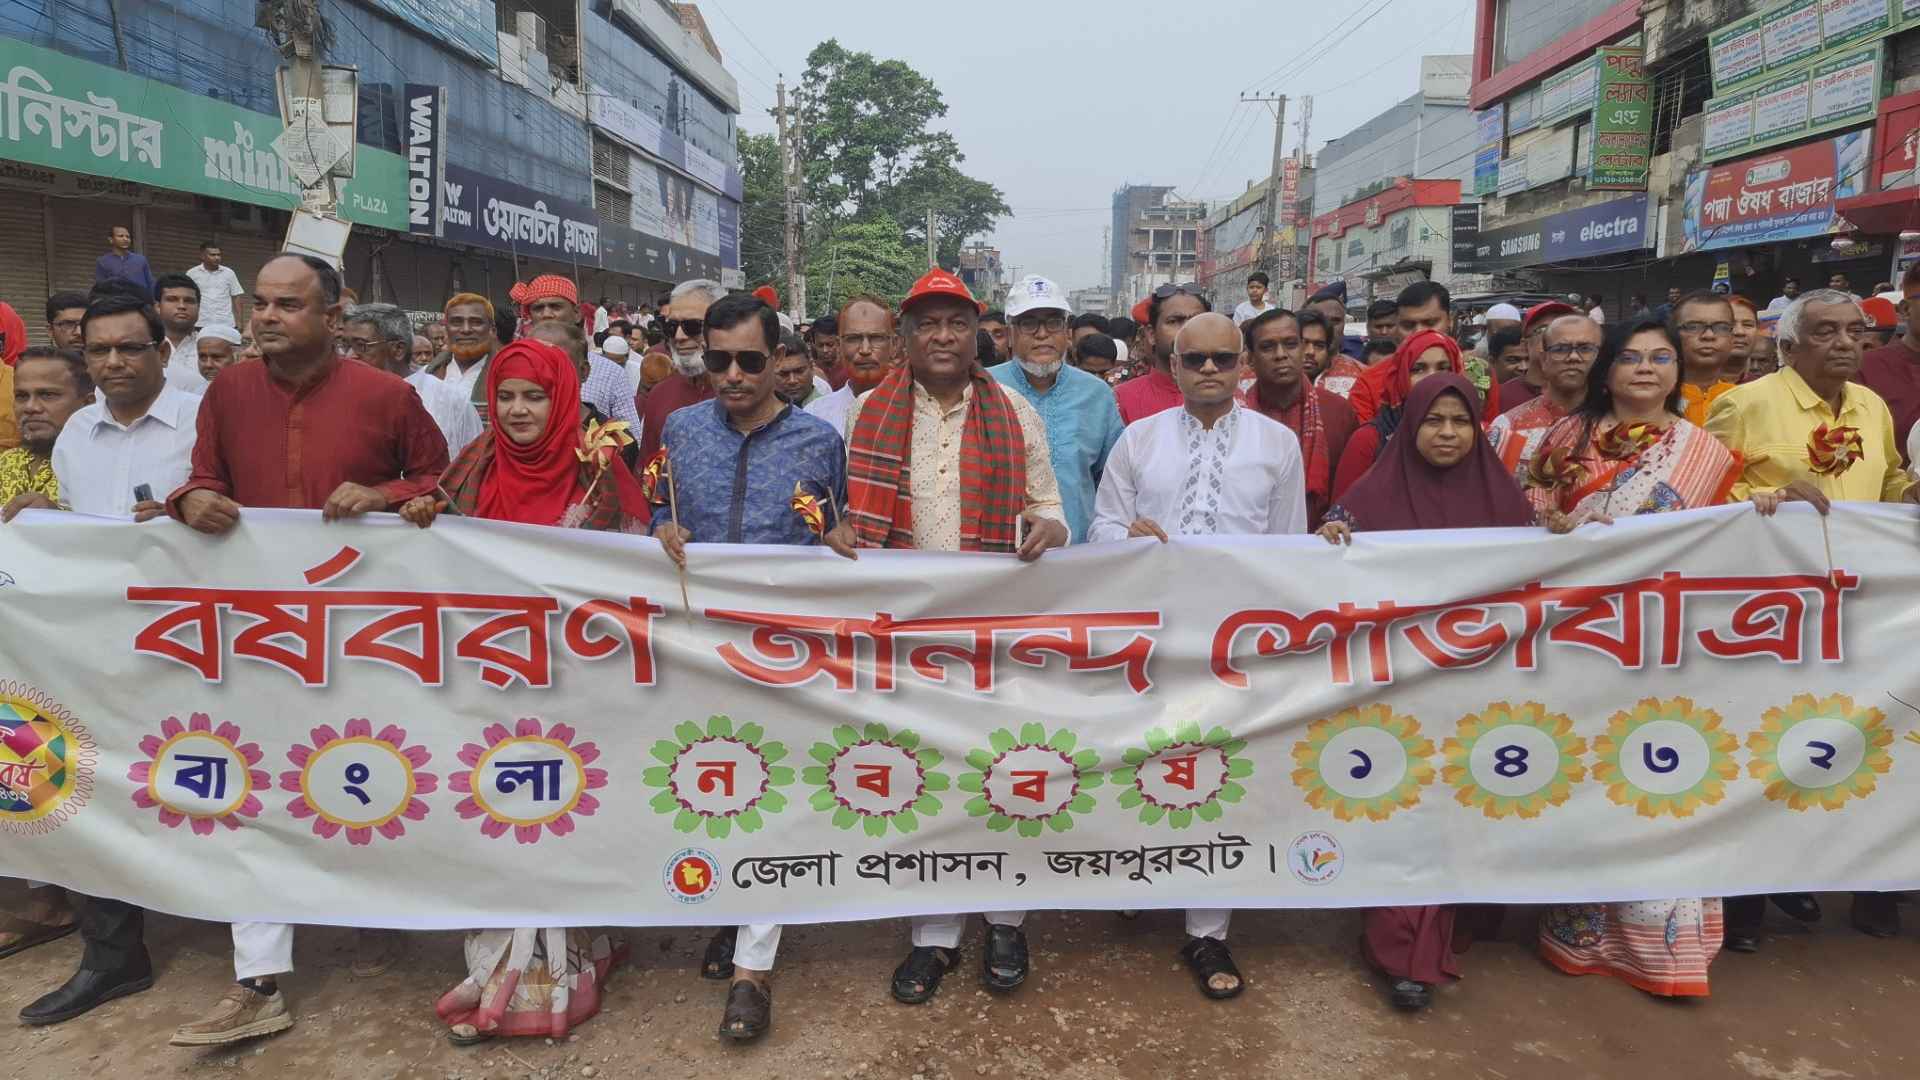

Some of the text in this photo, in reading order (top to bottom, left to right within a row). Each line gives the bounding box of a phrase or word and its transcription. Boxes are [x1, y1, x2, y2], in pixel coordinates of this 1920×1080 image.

[0, 66, 163, 169] নিস্টার
[409, 95, 433, 225] WALTON
[353, 193, 388, 214] PLAZA
[443, 206, 472, 227] ALTON
[1777, 176, 1833, 210] বাজার
[483, 198, 598, 257] ওয়ালটন প্লাজা
[1500, 232, 1541, 257] SAMSUNG
[1579, 215, 1638, 242] electra
[127, 546, 1858, 694] বর্ষবরণ আনন্দ শোভাযাত্রা
[174, 754, 228, 800] বা
[494, 759, 564, 801] লা
[697, 760, 736, 797] ন
[856, 763, 890, 798] ব
[1012, 770, 1049, 803] ব
[1164, 754, 1197, 790] র্ষ
[1350, 751, 1372, 779] ১
[1495, 745, 1527, 777] ৪
[1643, 742, 1680, 774] ৩
[1807, 741, 1835, 770] ২
[731, 850, 842, 889] জেলা
[1042, 831, 1252, 885] জয়পুরহাট
